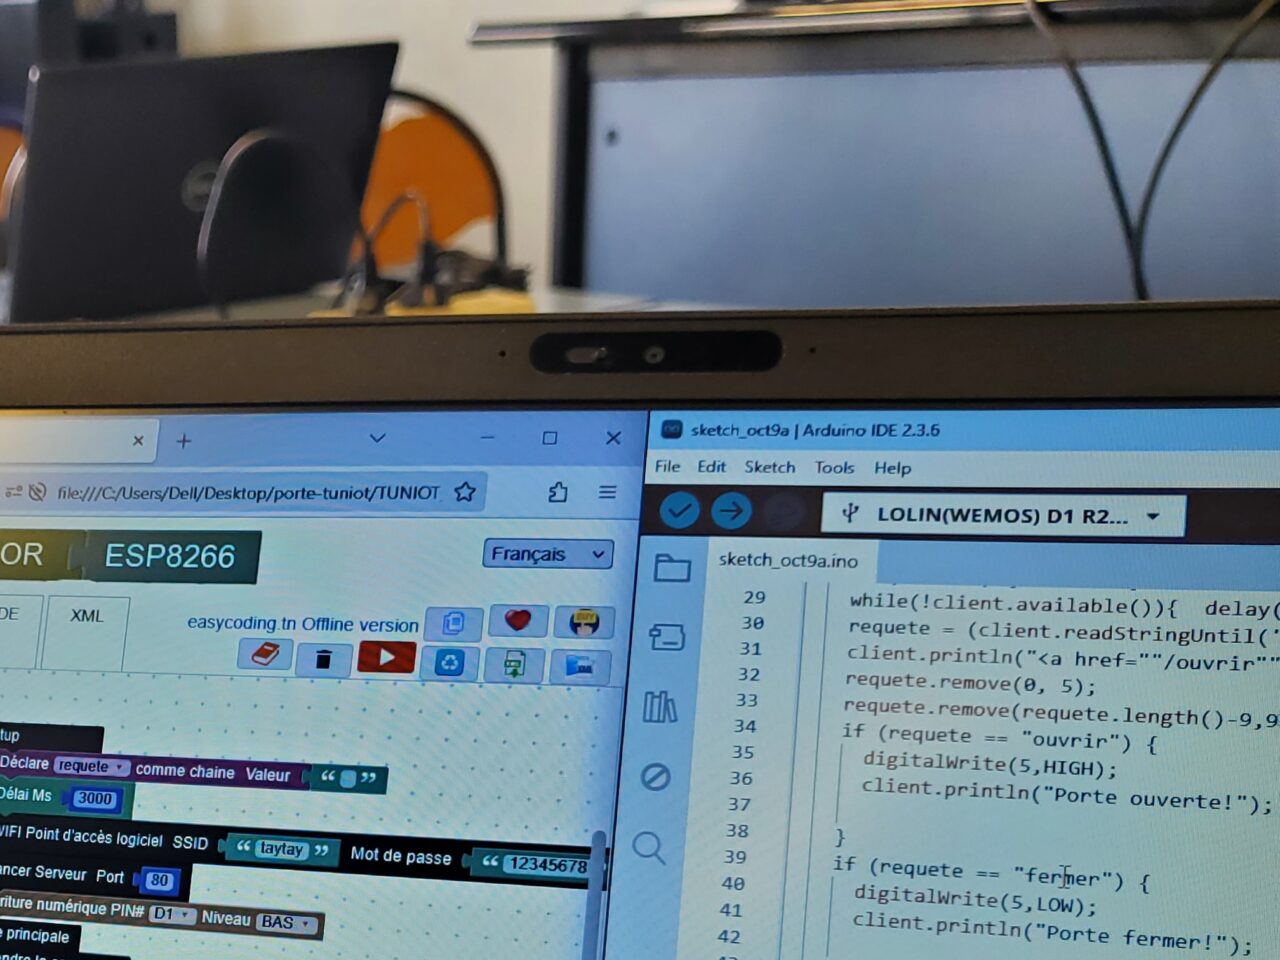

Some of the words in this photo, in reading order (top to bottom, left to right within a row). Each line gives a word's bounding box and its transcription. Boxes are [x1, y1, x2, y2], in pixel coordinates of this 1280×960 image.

[691, 423, 789, 438] sketch_oct9a
[803, 424, 866, 437] Arduino
[872, 424, 897, 437] IDE
[902, 424, 940, 437] 2.3.6
[656, 460, 680, 473] File
[698, 461, 726, 473] Edit
[745, 461, 795, 474] Sketch
[816, 461, 855, 474] Tools
[875, 462, 911, 478] Help
[878, 507, 1039, 525] LOLIN(WEMOS)
[1048, 509, 1073, 524] D1
[105, 543, 236, 569] ESP8266
[492, 545, 566, 564] Français
[720, 553, 858, 570] sketch_oct9a.ino
[744, 591, 766, 605] 29
[70, 609, 104, 623] XML
[188, 616, 296, 633] easycoding.tn
[302, 616, 354, 632] Offline
[359, 619, 419, 633] version
[849, 621, 930, 636] requete
[880, 726, 971, 744] (requete
[0, 755, 48, 770] Déclare
[59, 760, 109, 775] requete
[136, 763, 185, 778] comme
[190, 765, 235, 779] chaine
[247, 767, 291, 782] Valeur
[864, 751, 1116, 780] digitalWrite(5,HIGH);
[79, 792, 112, 806] 3000
[26, 826, 59, 841] Point
[63, 828, 112, 844] d'accès
[117, 832, 163, 848] logiciel
[173, 836, 208, 850] SSID
[261, 841, 303, 858] taytay
[351, 846, 378, 861] Mot
[384, 849, 401, 863] de
[407, 852, 452, 865] passe
[510, 856, 587, 874] 12345678
[35, 865, 86, 882] Serveur
[97, 868, 124, 884] Port
[151, 874, 168, 887] 80
[855, 885, 1096, 918] digitalWrite(5,LOW);
[37, 897, 107, 916] numérique
[111, 903, 144, 917] PIN#
[202, 910, 251, 926] Niveau
[262, 916, 293, 929] BAS
[7, 928, 69, 944] principale
